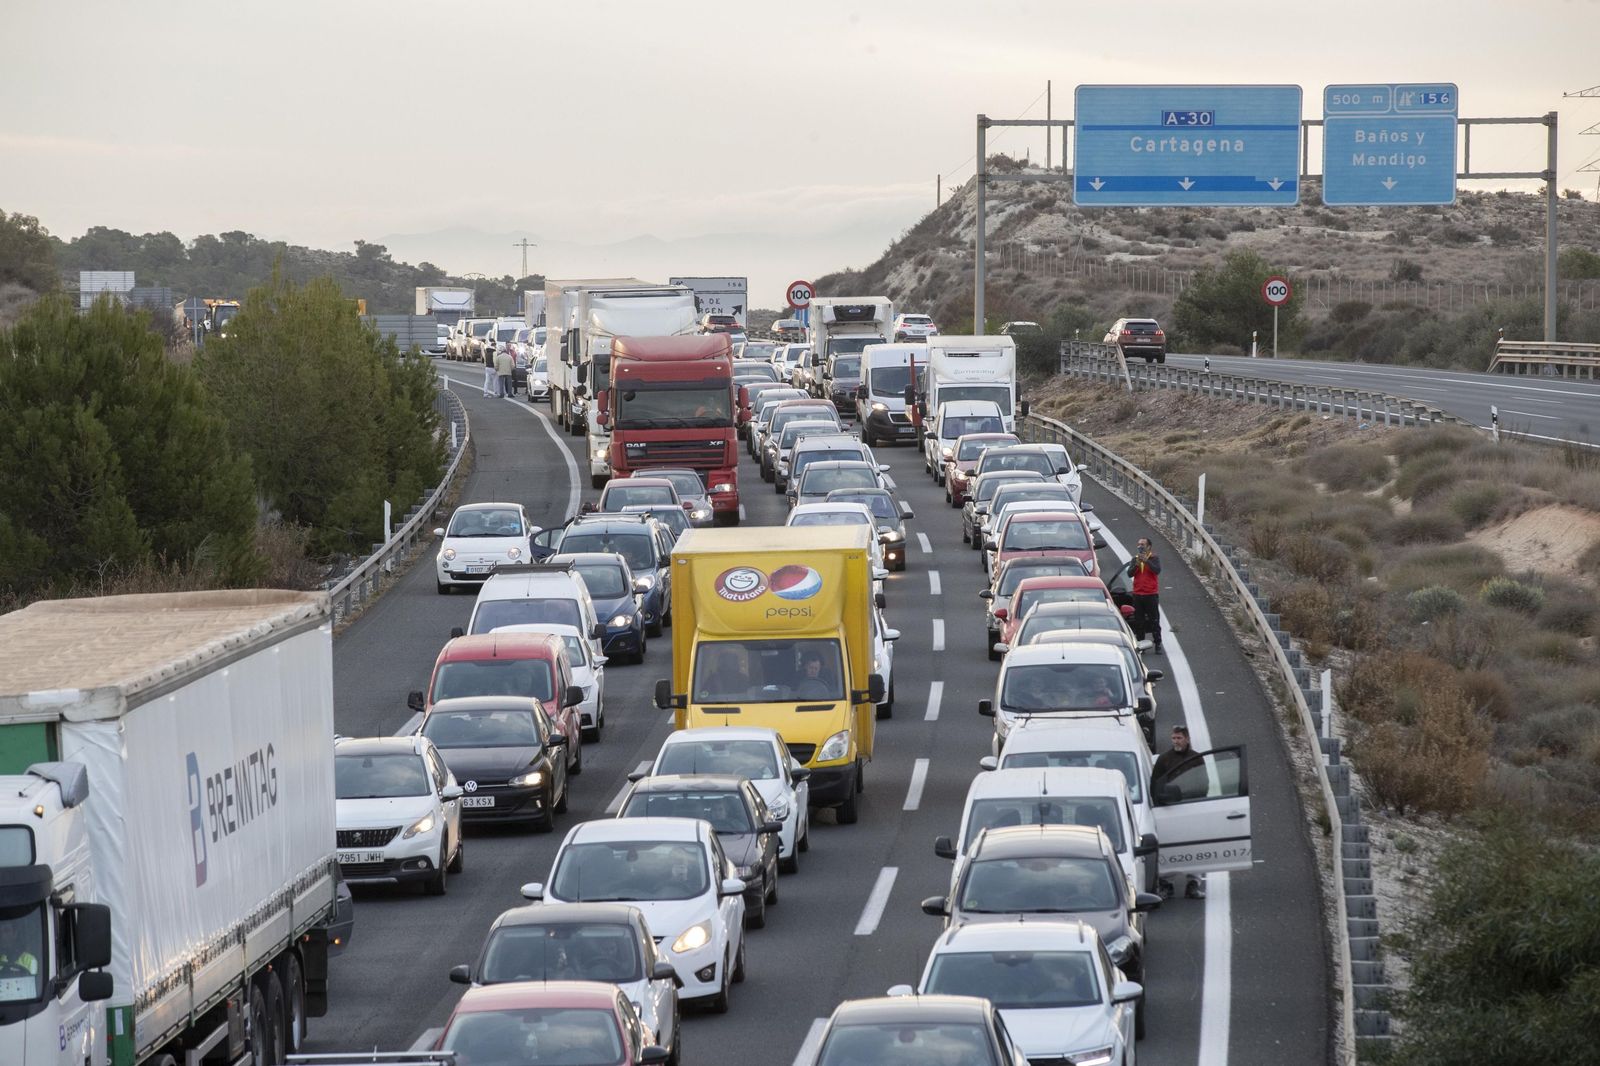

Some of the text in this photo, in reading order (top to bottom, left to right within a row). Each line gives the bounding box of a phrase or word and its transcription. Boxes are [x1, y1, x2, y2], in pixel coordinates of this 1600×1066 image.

[1332, 94, 1384, 105] 500 m
[1420, 93, 1449, 104] 156
[1166, 111, 1211, 125] A-30
[1355, 129, 1426, 146] Baños y
[1130, 136, 1245, 156] Cartagena
[1352, 152, 1427, 169] Mendigo
[791, 289, 811, 300] 100
[1267, 285, 1287, 296] 100
[708, 297, 721, 305] DE
[718, 585, 767, 601] Matutano
[765, 605, 812, 619] pepsi
[206, 742, 278, 844] BRENNTAG
[463, 798, 493, 807] 63 KSX
[338, 853, 361, 863] 7951
[1168, 853, 1193, 864] 620
[1195, 851, 1218, 861] 891
